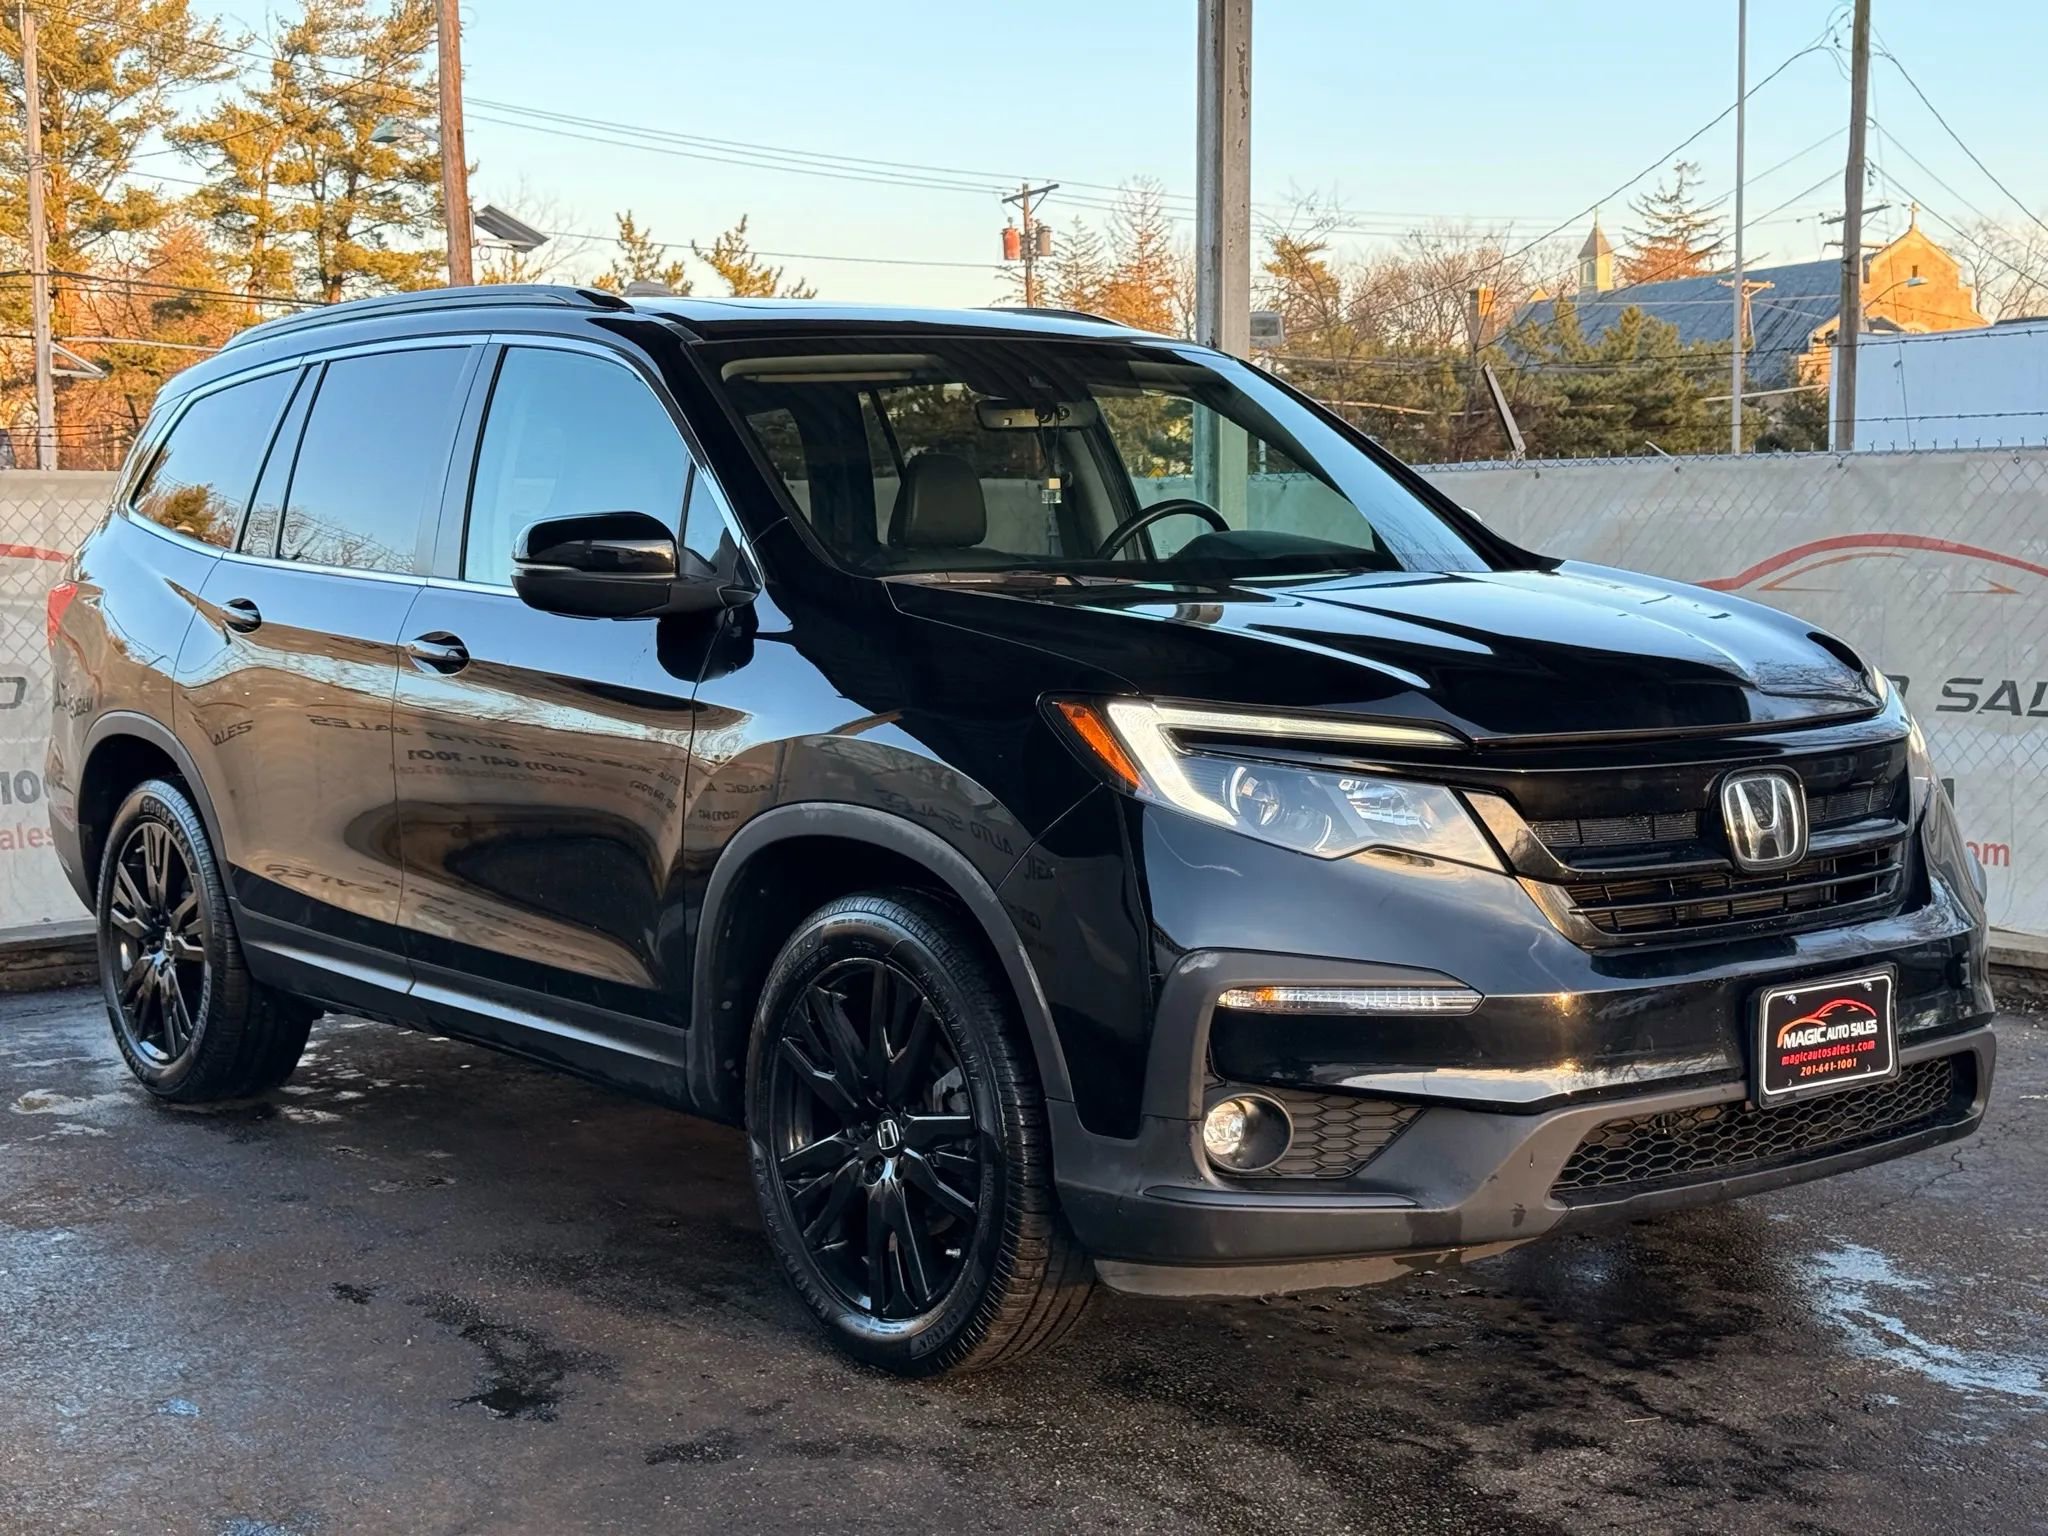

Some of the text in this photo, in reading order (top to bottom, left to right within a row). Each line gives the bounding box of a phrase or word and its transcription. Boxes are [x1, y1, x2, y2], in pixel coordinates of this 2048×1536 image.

[1783, 1019, 1878, 1049] MAGIC AUTO SALES
[1781, 1039, 1876, 1066] magicautosales1.com
[1800, 1057, 1858, 1077] 201-641-1001
